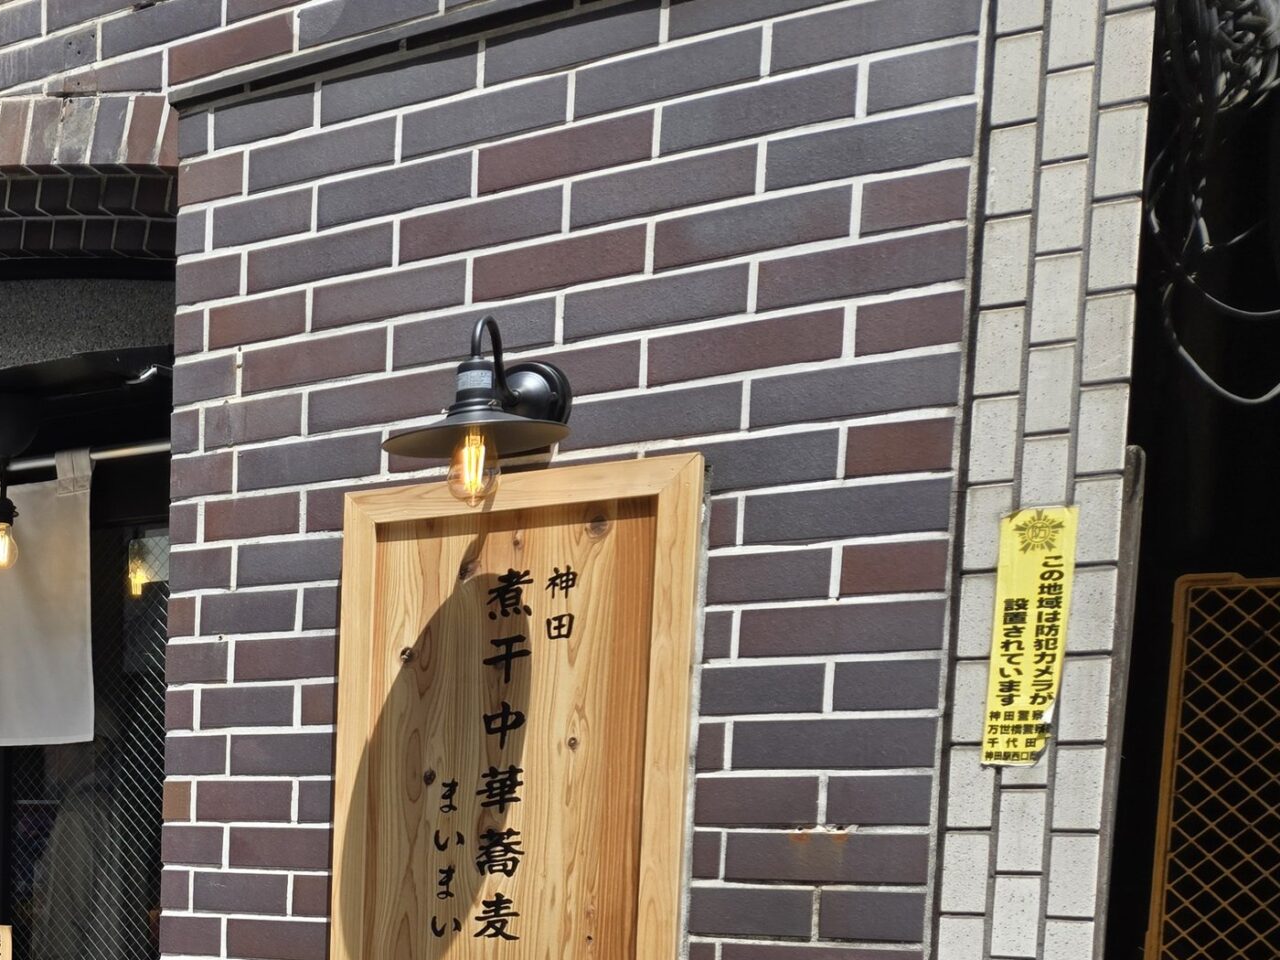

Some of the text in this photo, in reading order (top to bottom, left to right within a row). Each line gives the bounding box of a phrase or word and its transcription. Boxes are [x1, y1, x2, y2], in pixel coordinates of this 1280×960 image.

[545, 565, 578, 640] 神田
[995, 598, 1029, 707] 設置されています
[1029, 555, 1065, 706] この地域は防犯カメラが
[473, 568, 534, 942] 煮干中華蕎麦
[431, 777, 465, 938] まいまい
